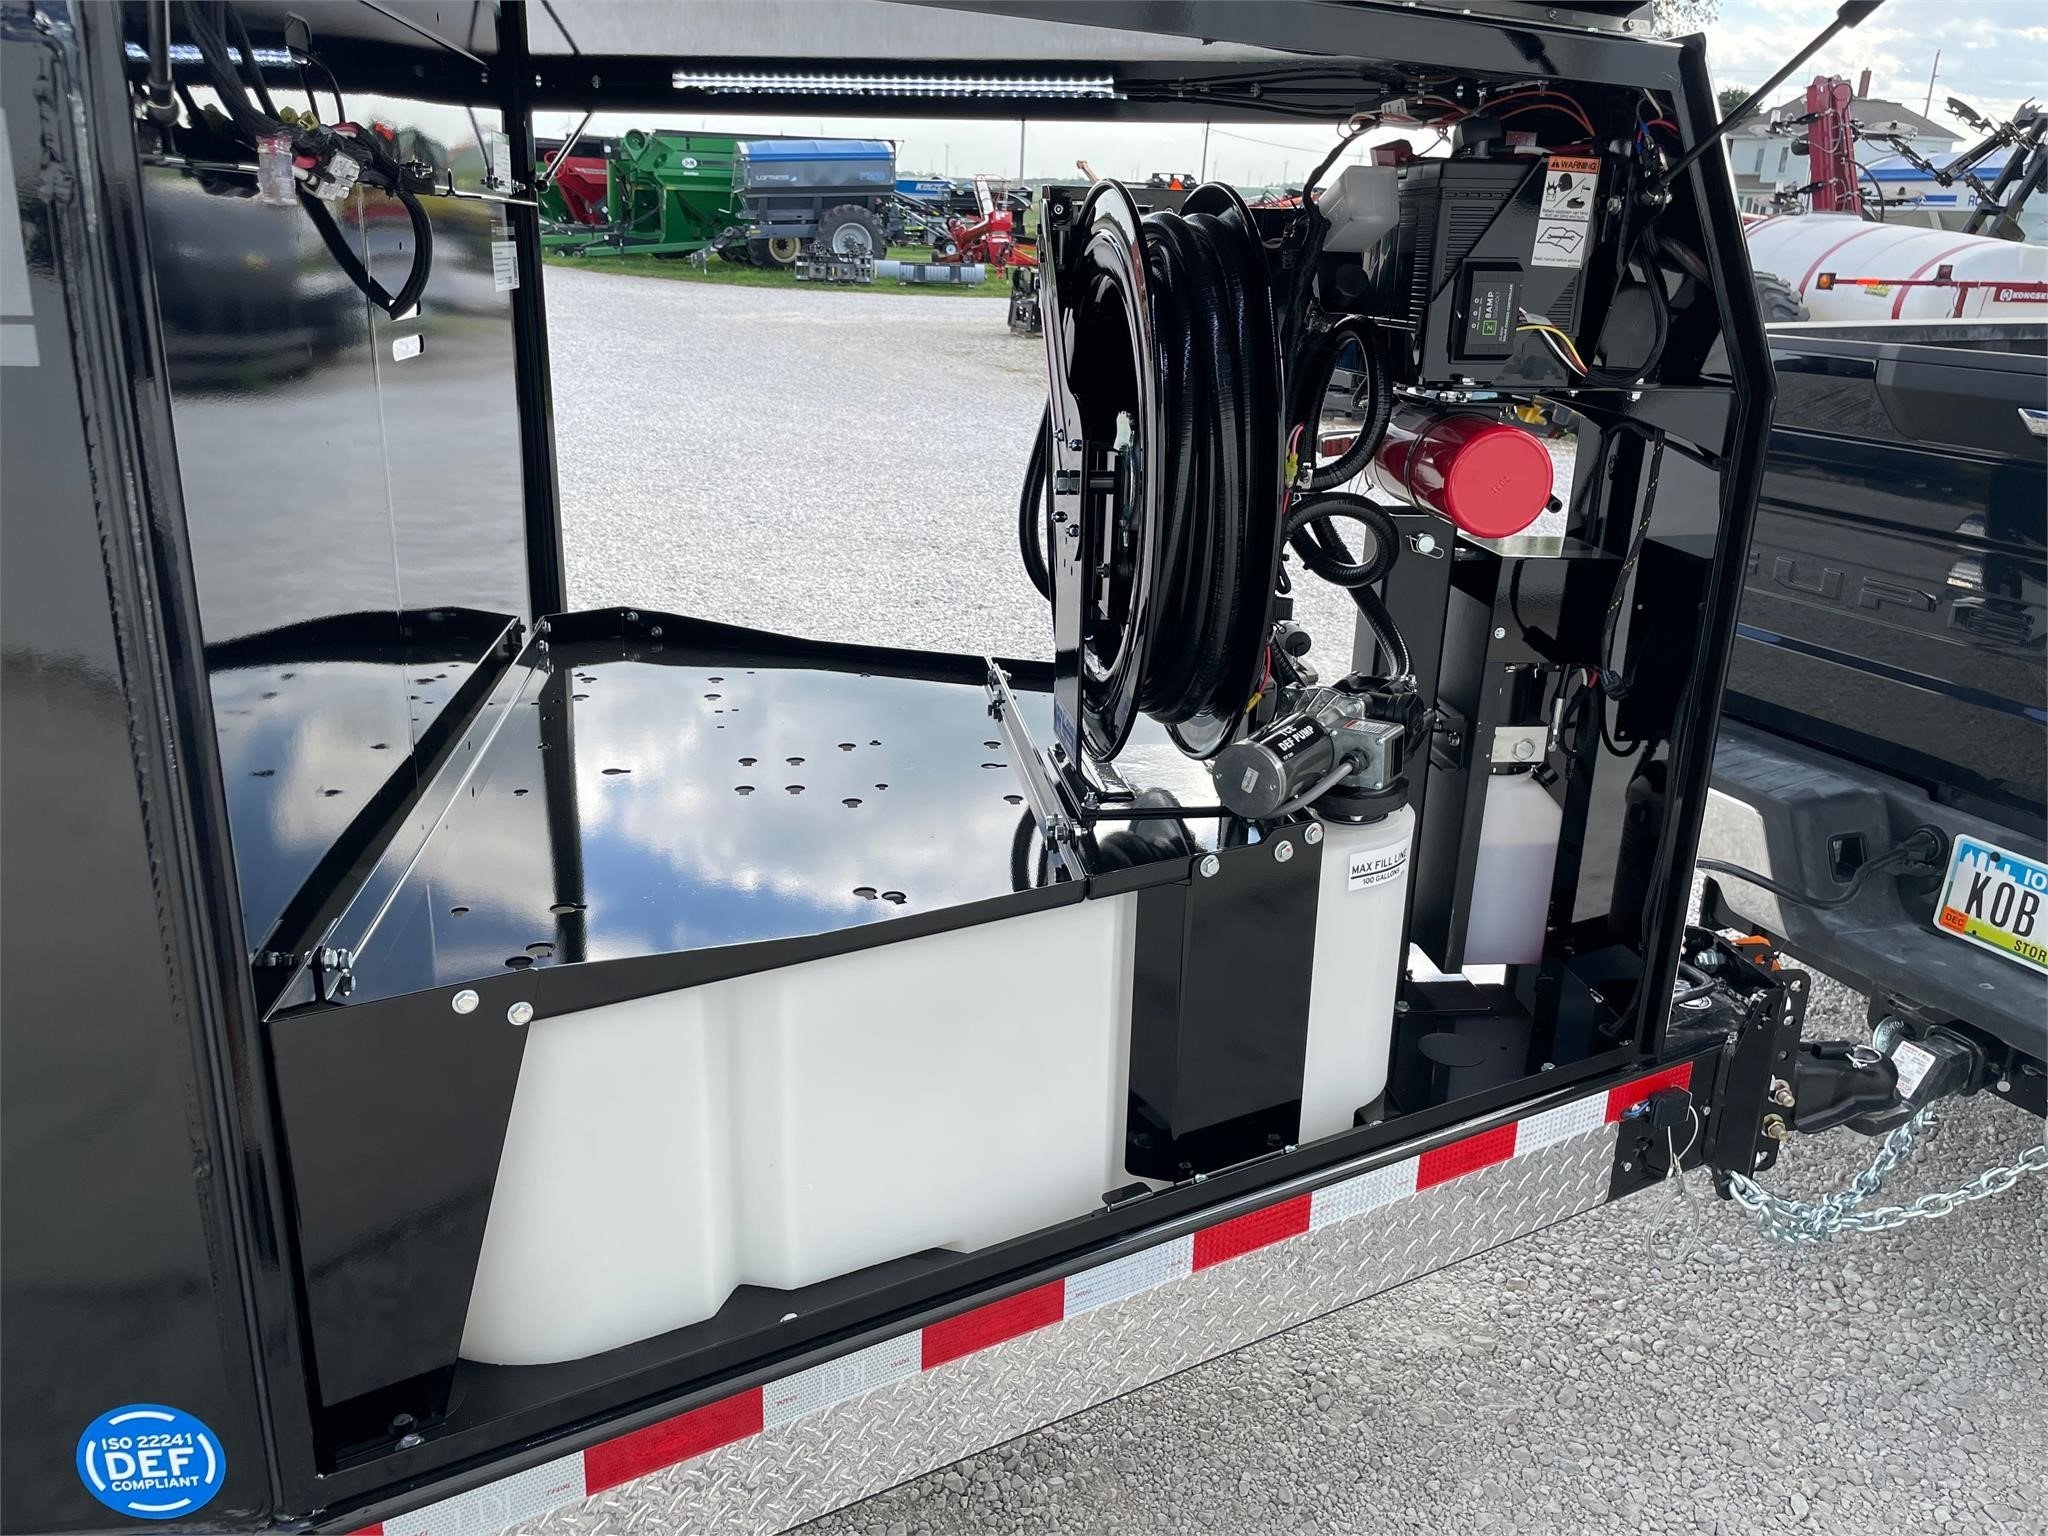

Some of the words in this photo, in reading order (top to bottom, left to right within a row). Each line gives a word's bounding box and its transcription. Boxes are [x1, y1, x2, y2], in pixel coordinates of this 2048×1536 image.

[1561, 160, 1597, 171] WARNING
[1277, 737, 1295, 752] DEF
[1292, 725, 1315, 743] PUMP
[1351, 861, 1373, 875] MAX
[1375, 856, 1393, 870] FILL
[1394, 847, 1408, 864] LINE
[1363, 876, 1375, 885] 100
[1375, 867, 1400, 882] GALLONS
[1965, 871, 2041, 938] KOB
[1945, 912, 1965, 927] DEC
[2014, 939, 2048, 963] STOR
[101, 1436, 133, 1451] ISO
[136, 1432, 193, 1449] 22241
[104, 1446, 195, 1481] DEF
[111, 1475, 200, 1492] COMPLIANT
